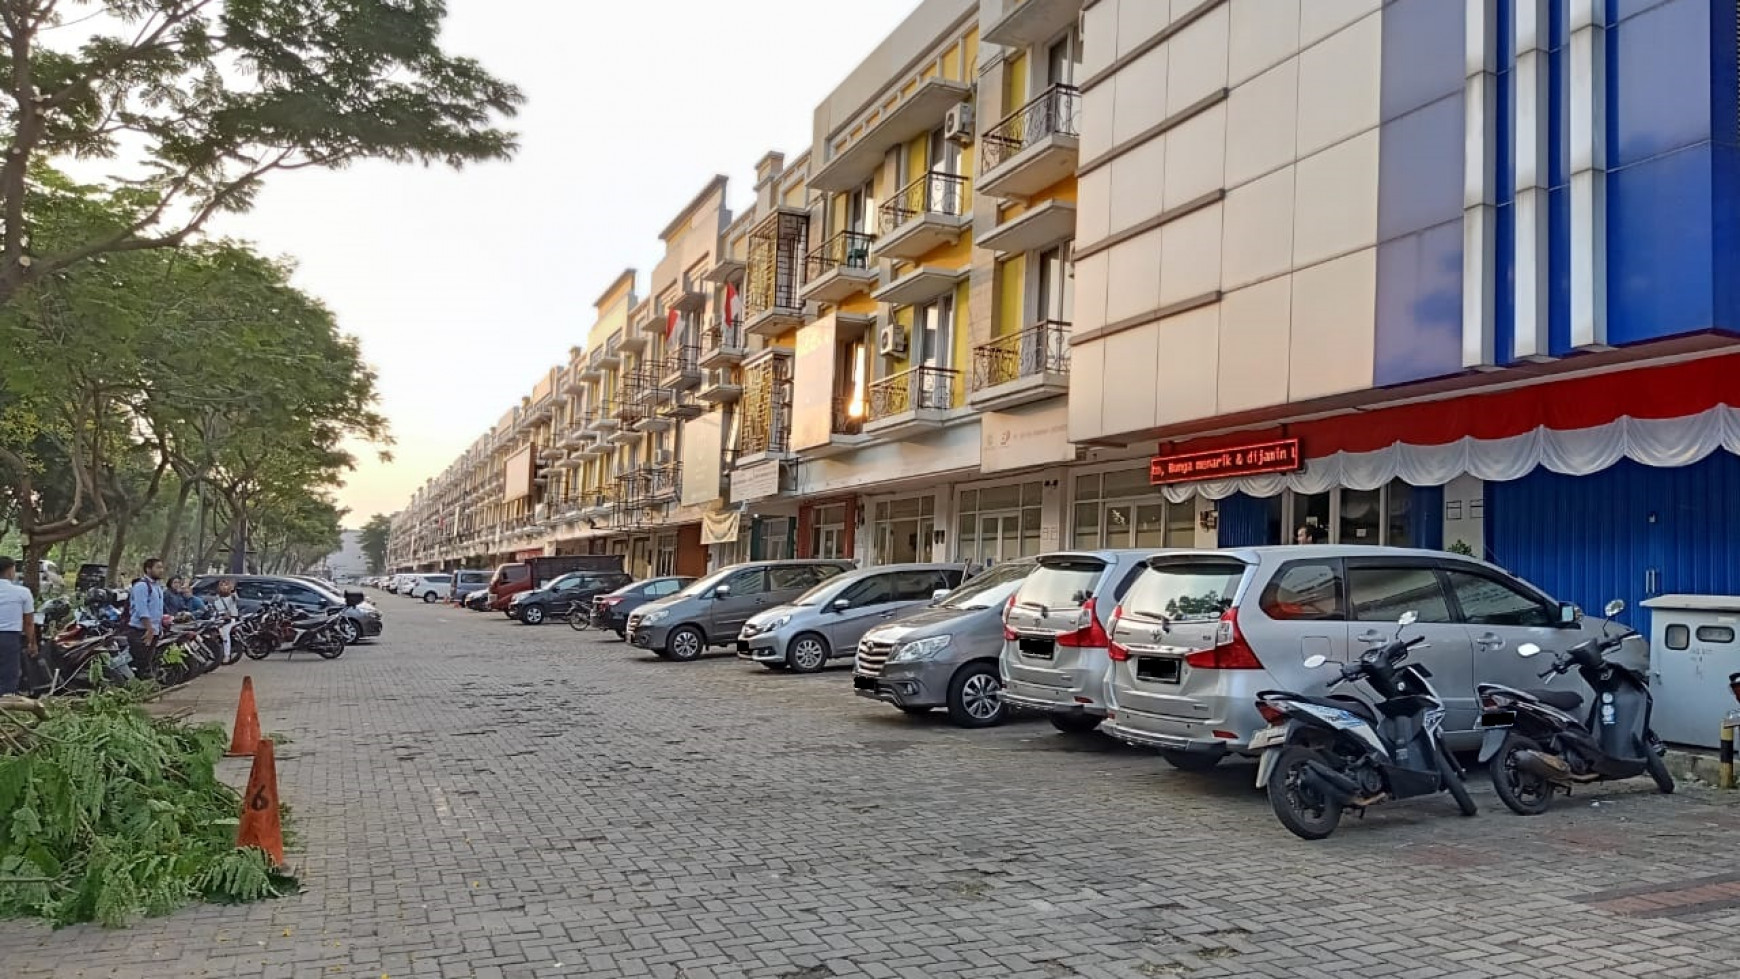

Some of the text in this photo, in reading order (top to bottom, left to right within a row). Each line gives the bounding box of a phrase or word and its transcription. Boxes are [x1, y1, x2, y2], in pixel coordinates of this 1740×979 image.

[1195, 453, 1232, 470] menarik
[1236, 453, 1244, 466] &
[1247, 446, 1287, 465] dijamin
[251, 784, 269, 811] 6
